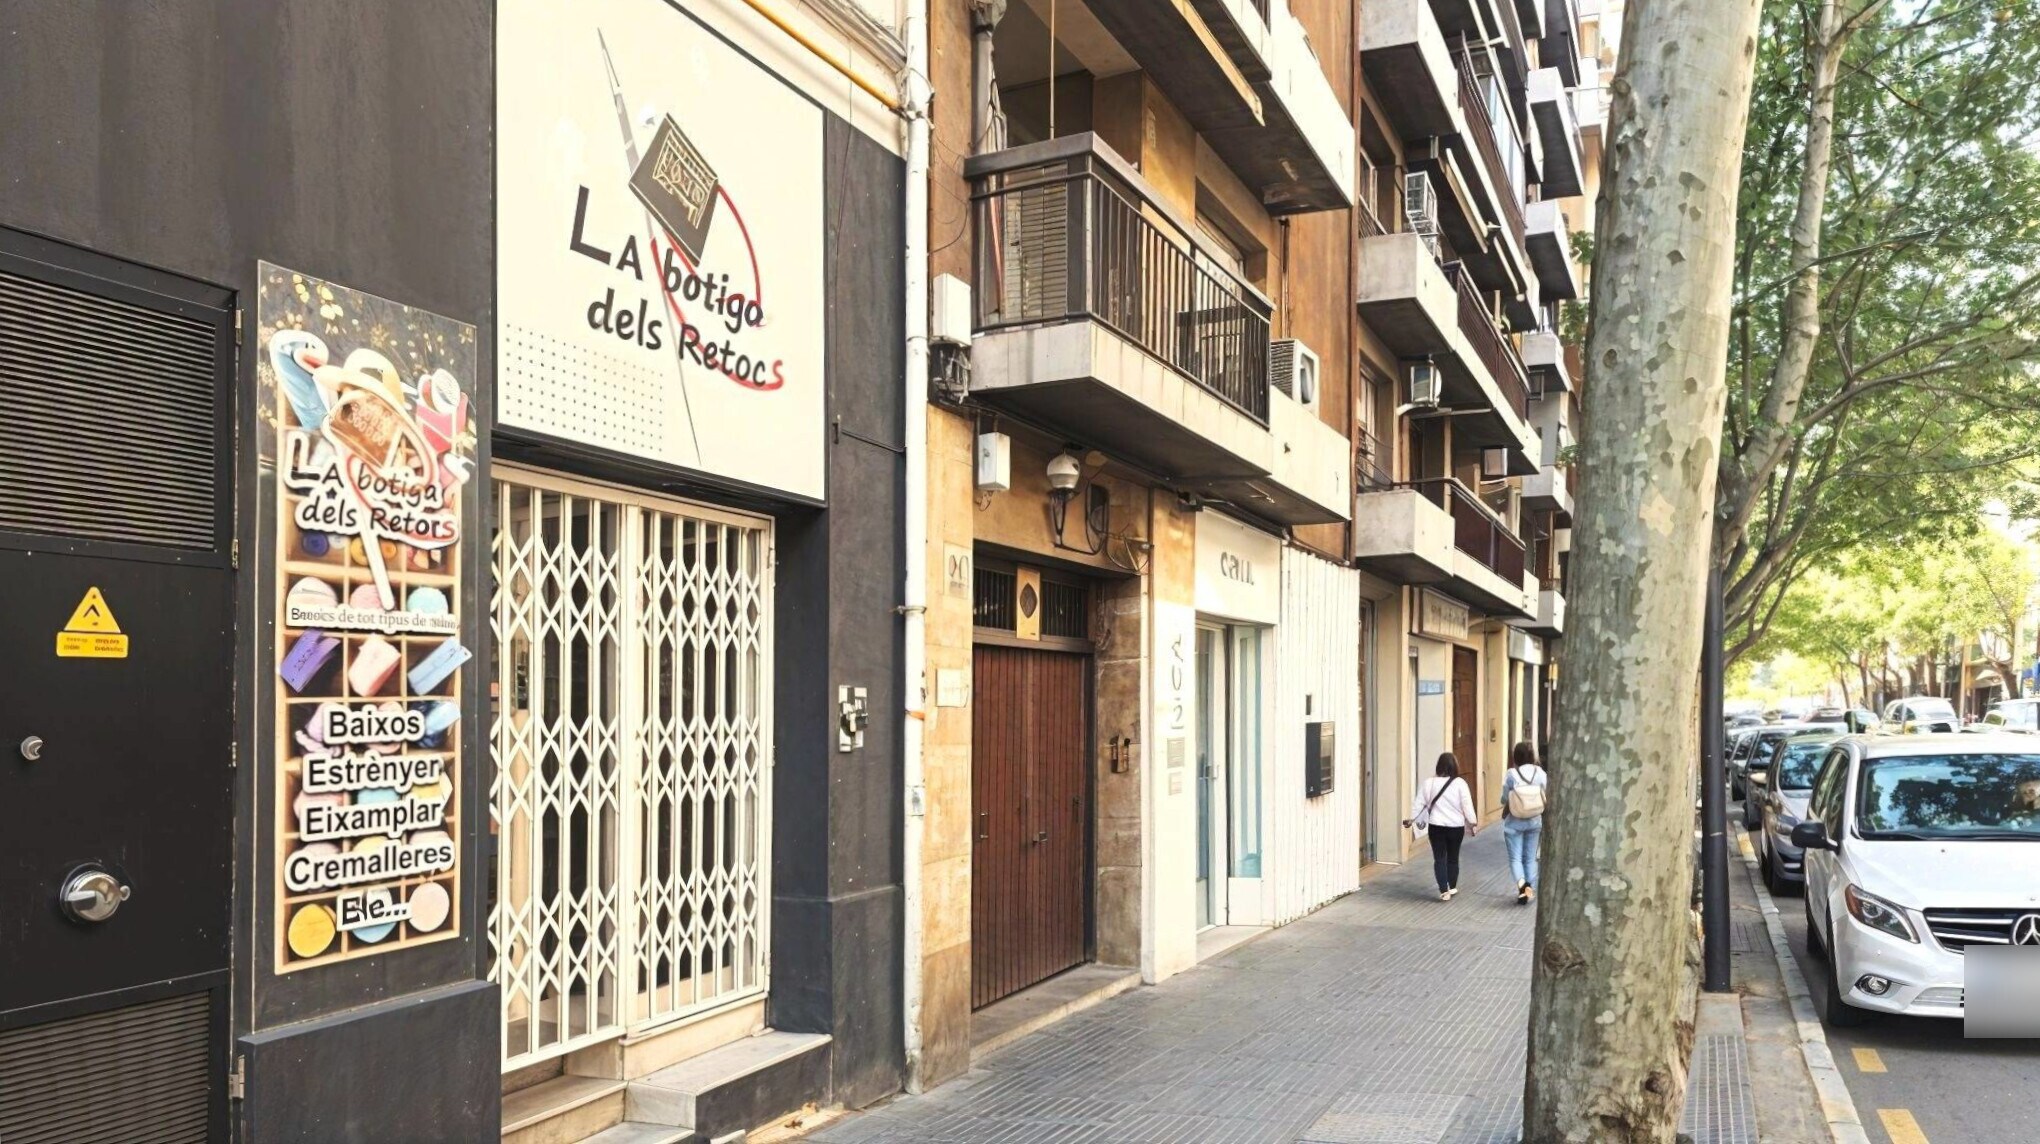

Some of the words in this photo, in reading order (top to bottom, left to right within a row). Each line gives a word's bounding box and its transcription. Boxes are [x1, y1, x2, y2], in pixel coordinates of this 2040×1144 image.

[569, 184, 644, 281] LA
[663, 247, 765, 334] botiga
[586, 287, 662, 351] dels
[678, 323, 784, 391] Retocs
[357, 463, 437, 508] botiga
[301, 495, 357, 528] dels
[328, 710, 421, 738] Baixos
[307, 755, 441, 787] Estrènyer
[305, 798, 442, 835] Eixamplar
[289, 844, 452, 885] Cremalleres
